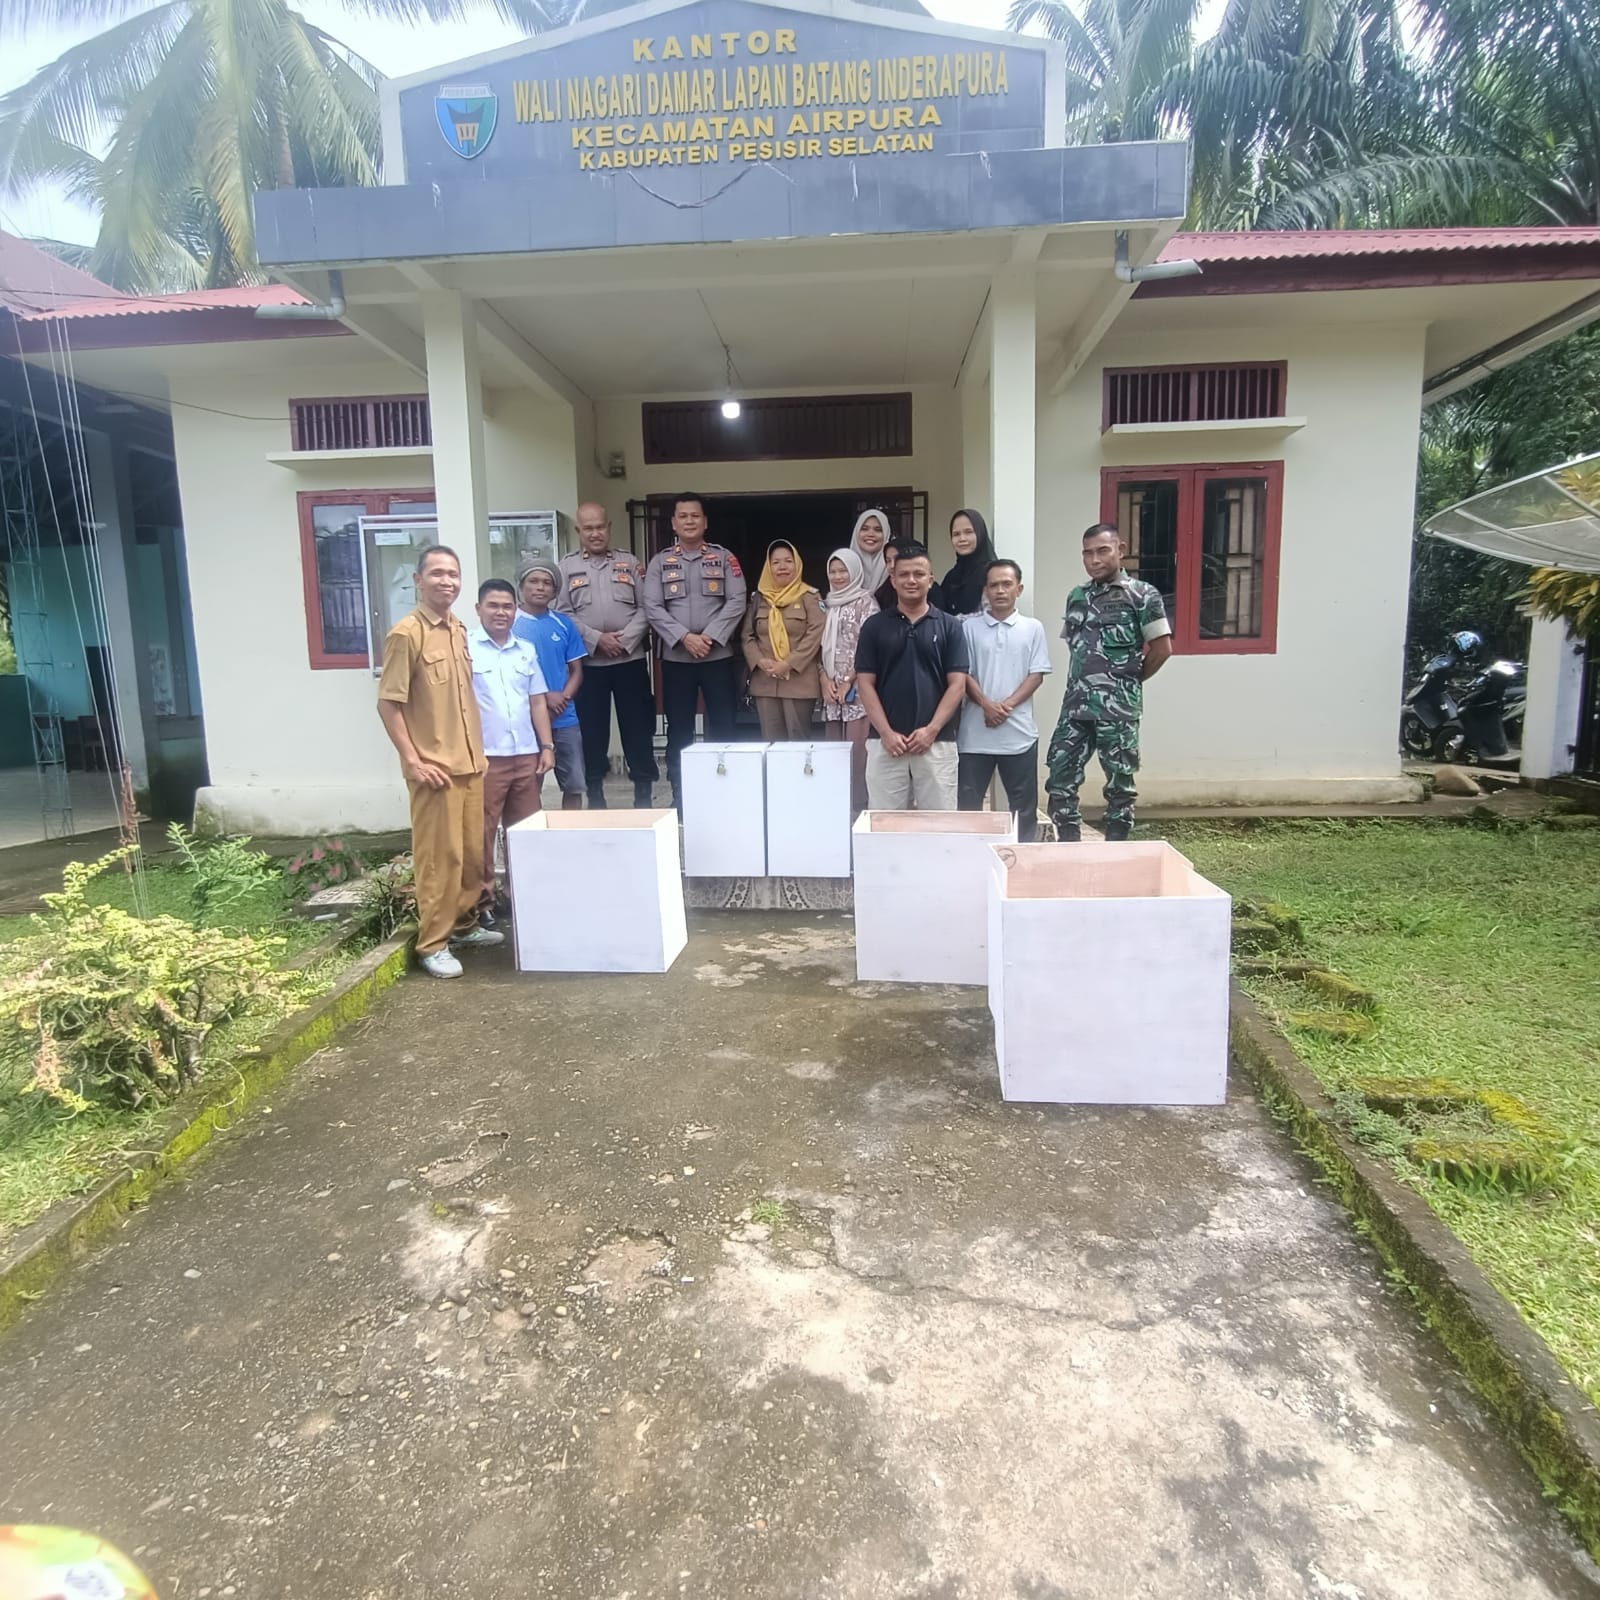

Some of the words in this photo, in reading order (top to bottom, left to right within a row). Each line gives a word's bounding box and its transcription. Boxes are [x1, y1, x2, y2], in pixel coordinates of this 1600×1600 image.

[632, 28, 797, 62] KANTOR
[513, 79, 562, 123] WALI
[566, 73, 643, 121] NAGARI
[645, 67, 717, 116] DAMAR
[722, 64, 787, 110] LAPAN
[792, 59, 872, 107] BATANG
[877, 51, 1009, 102] INDERAPURA
[572, 116, 775, 149] KECAMATAN
[786, 104, 943, 136] AIRPURA
[579, 144, 719, 171] KABUPATEN
[728, 138, 823, 162] PESISIR
[828, 132, 934, 157] SELATAN
